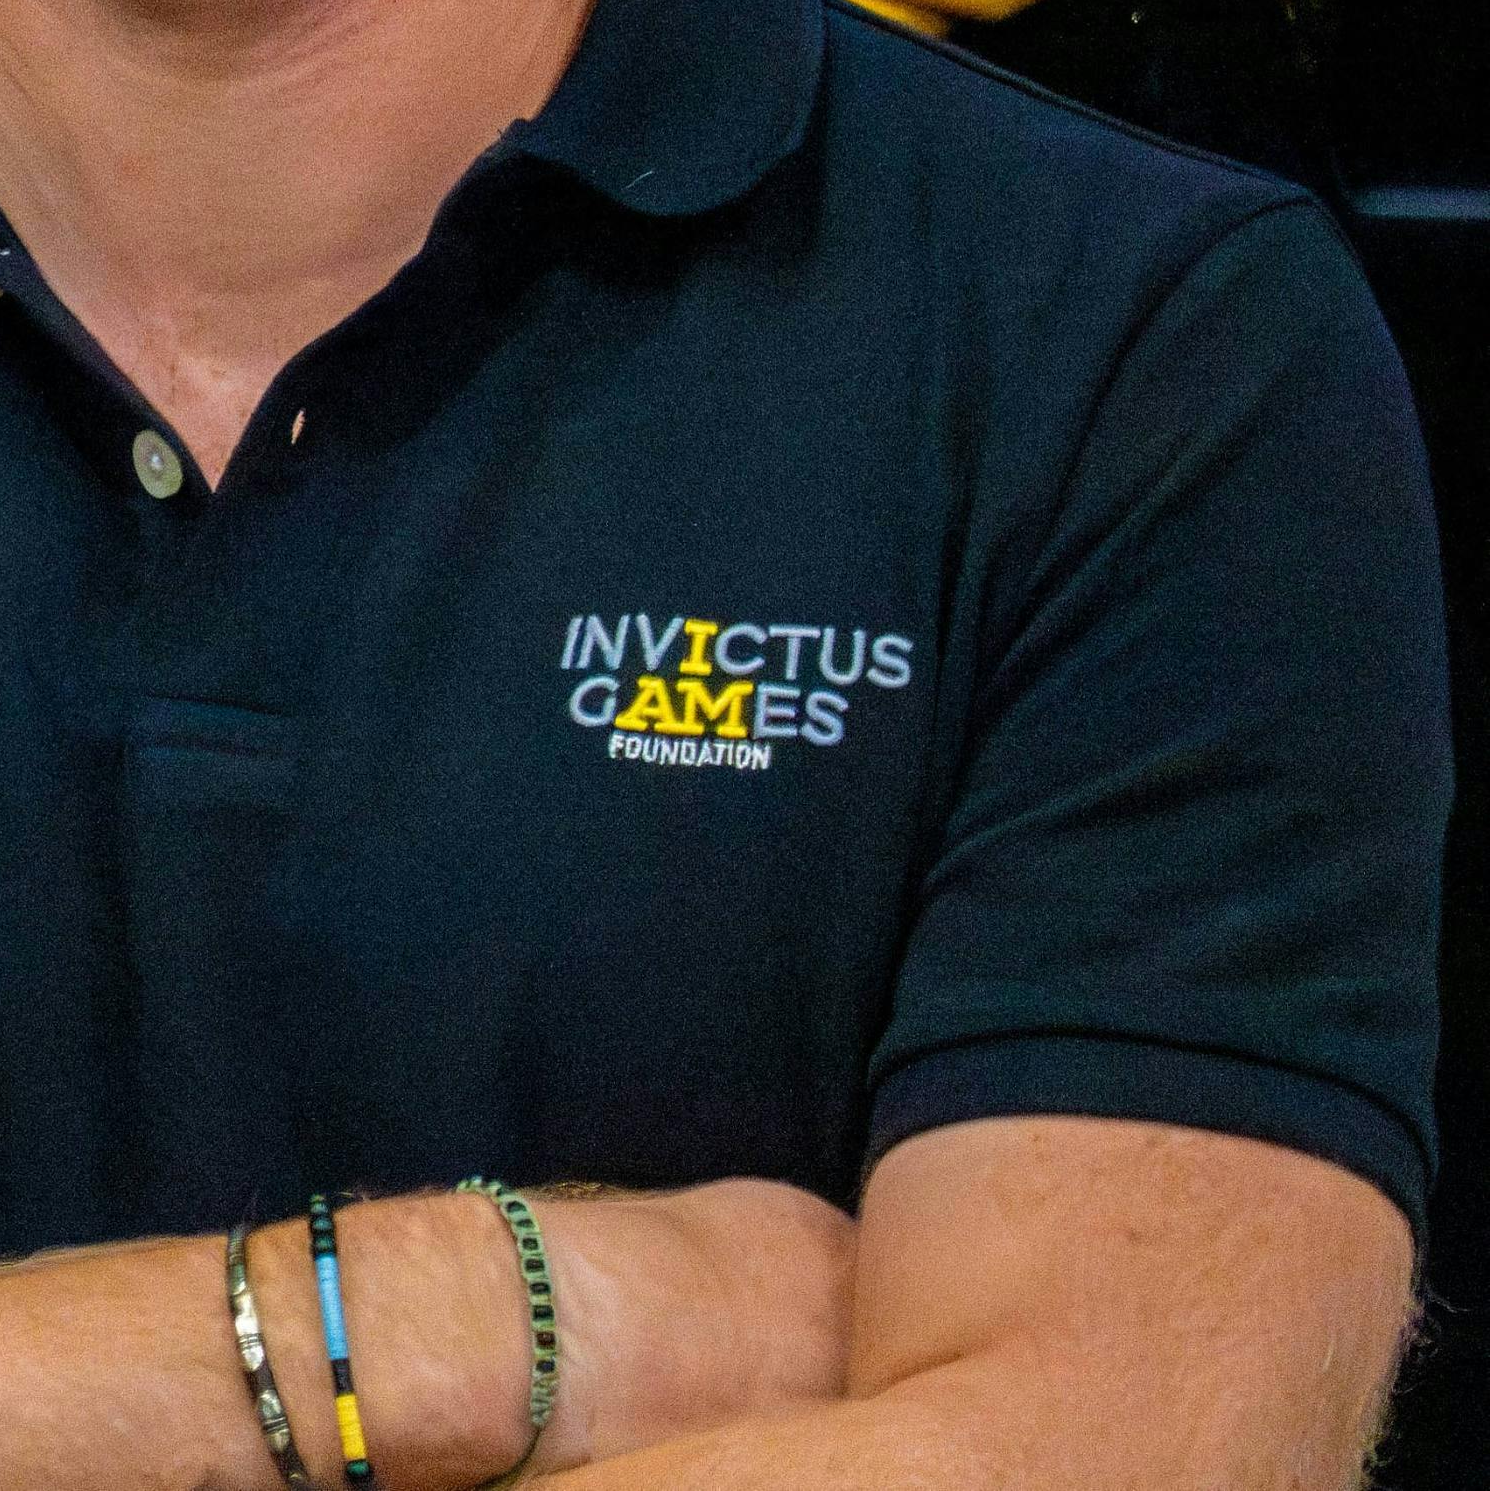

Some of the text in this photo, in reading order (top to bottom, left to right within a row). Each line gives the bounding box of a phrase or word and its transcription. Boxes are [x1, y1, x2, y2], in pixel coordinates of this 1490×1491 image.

[560, 613, 915, 689] INVICTUS
[568, 674, 850, 746] GAMES
[608, 733, 773, 770] FOUNDATION
